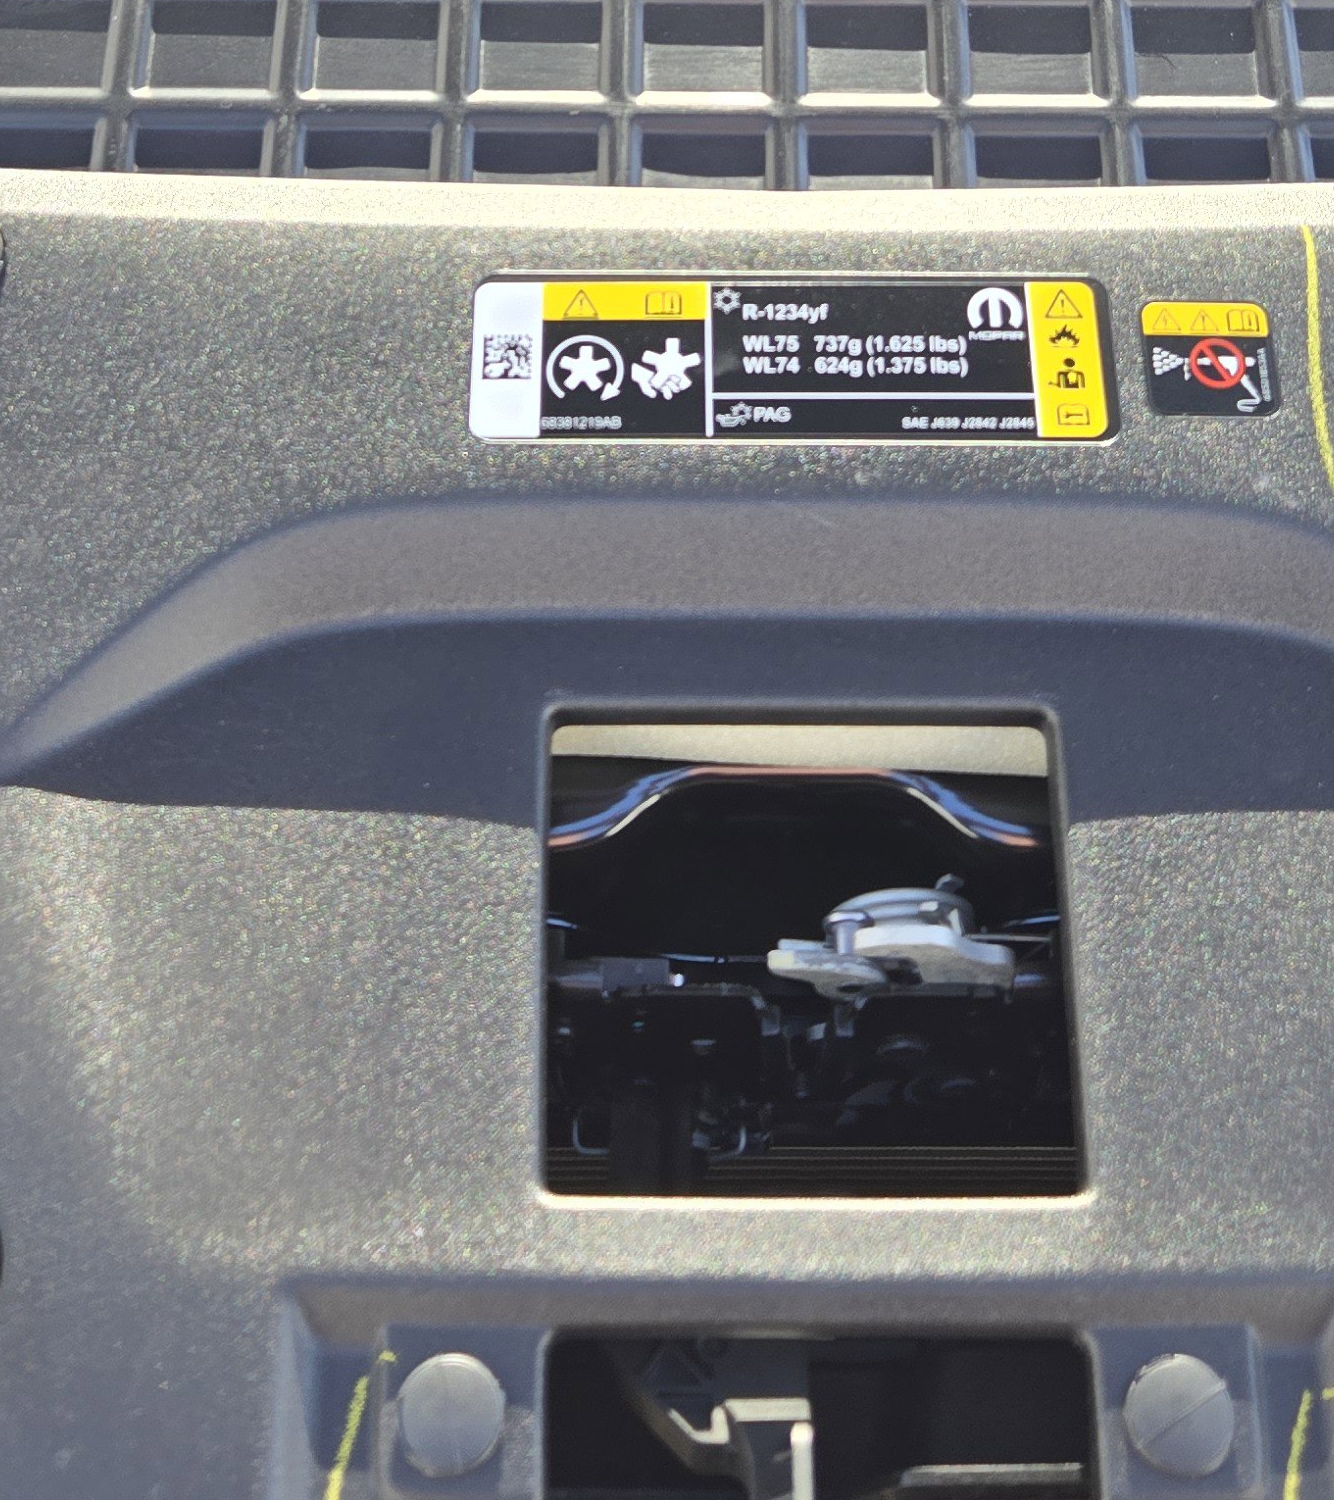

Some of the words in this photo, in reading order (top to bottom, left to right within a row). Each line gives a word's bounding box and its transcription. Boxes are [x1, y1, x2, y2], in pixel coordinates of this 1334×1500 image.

[742, 303, 829, 324] R-1234yf
[742, 334, 800, 353] WL75
[813, 334, 863, 356] 737g
[865, 334, 925, 357] (1.625
[929, 334, 967, 357] lbs)
[968, 330, 1026, 342] MOPAR
[742, 356, 800, 374] WL74
[814, 356, 863, 378] 624g
[866, 356, 926, 378] (1.375
[930, 356, 968, 378] lbs)
[753, 406, 791, 423] PAG
